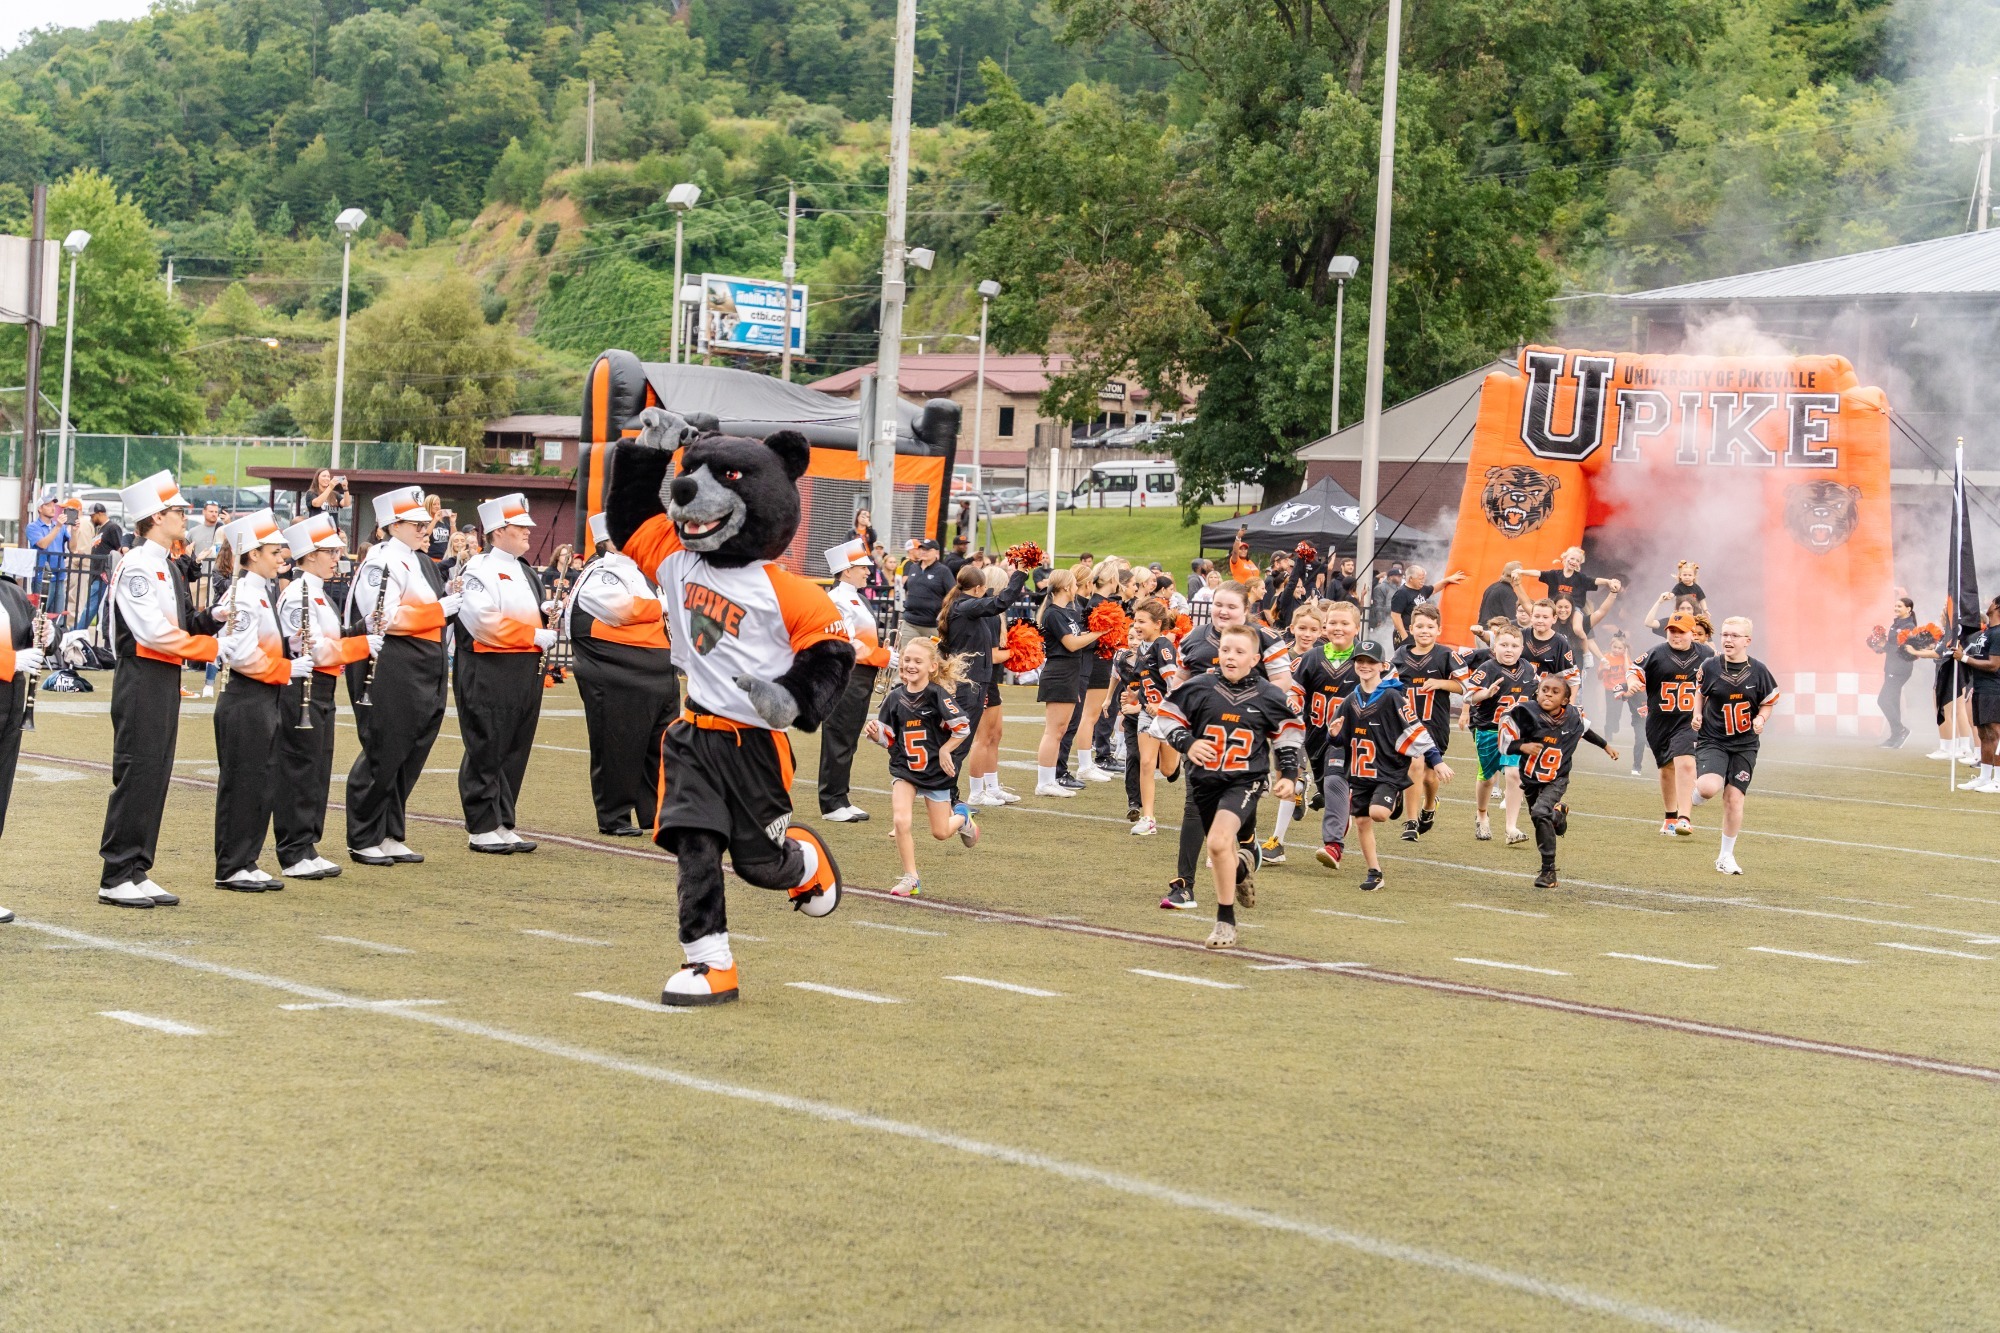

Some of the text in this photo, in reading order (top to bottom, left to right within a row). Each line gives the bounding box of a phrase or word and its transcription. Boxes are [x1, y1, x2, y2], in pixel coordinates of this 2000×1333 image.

[1624, 365, 1816, 389] UNIVERSITY OF PIKEVILLE
[1519, 349, 1841, 469] UPIKE
[685, 582, 747, 639] UPIKE
[943, 698, 960, 714] 5
[1405, 687, 1436, 721] 17
[1659, 682, 1695, 712] 56
[1221, 713, 1241, 723] UPIKE
[1722, 701, 1751, 736] 16
[903, 729, 928, 771] 5
[1350, 738, 1378, 778] 12
